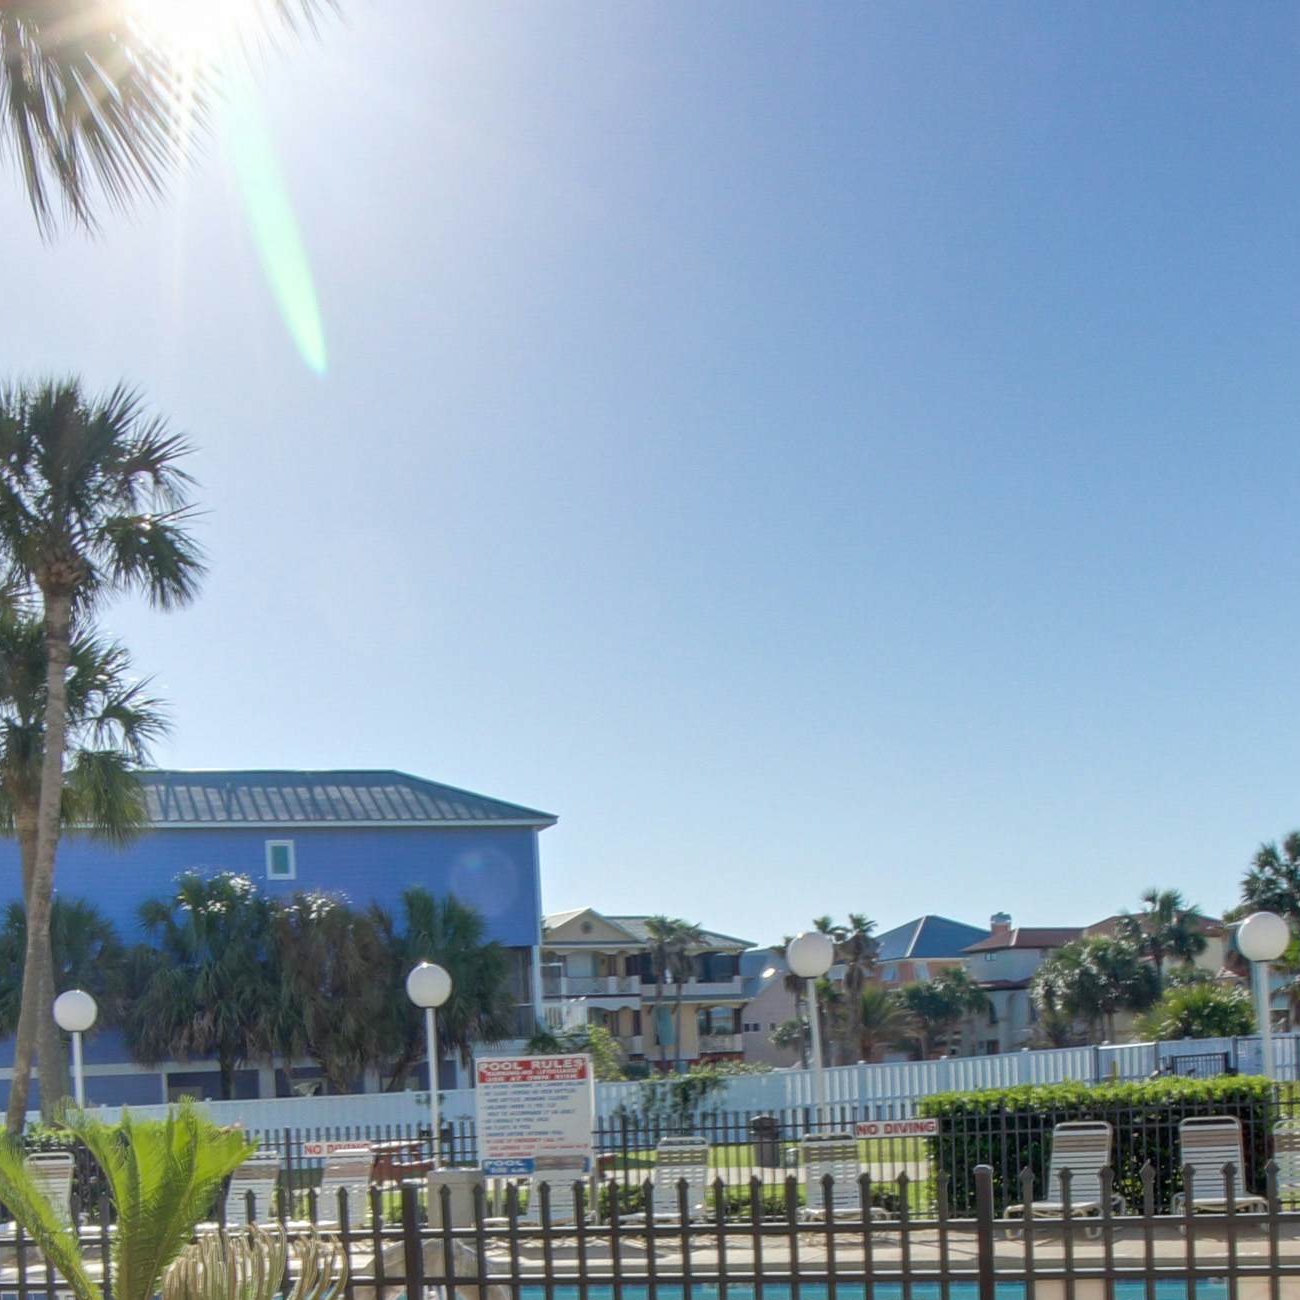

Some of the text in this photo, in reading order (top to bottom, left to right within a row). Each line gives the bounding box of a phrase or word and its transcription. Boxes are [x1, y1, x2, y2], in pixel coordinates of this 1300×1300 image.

[479, 1059, 583, 1071] POOL RULES
[856, 1121, 935, 1136] NO DIVING
[304, 1144, 321, 1155] NO
